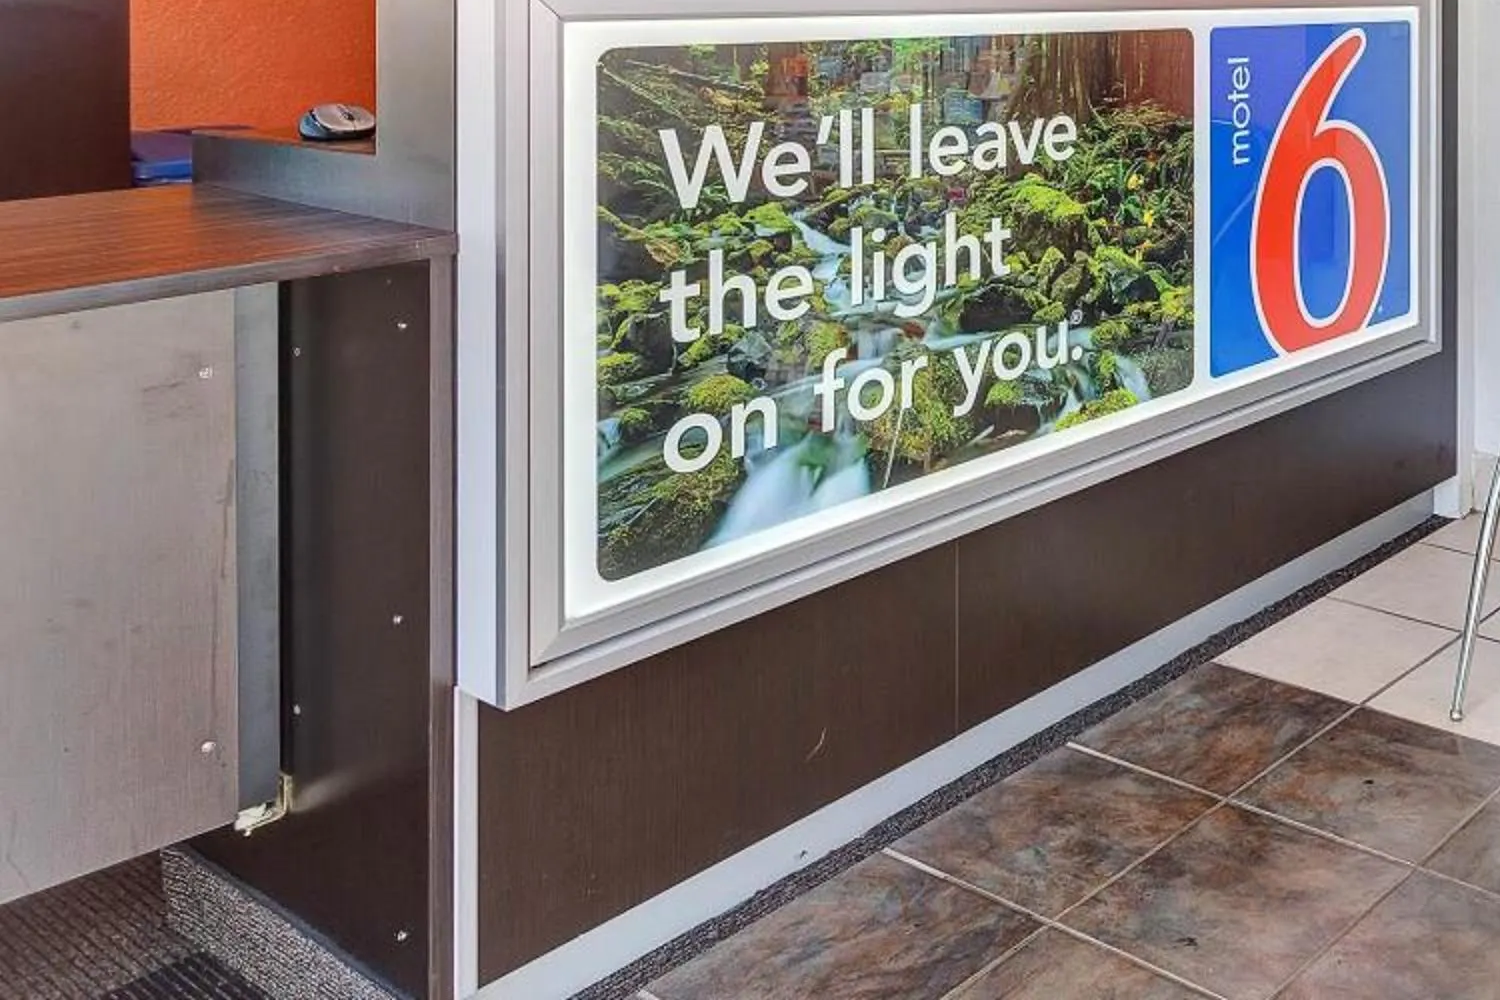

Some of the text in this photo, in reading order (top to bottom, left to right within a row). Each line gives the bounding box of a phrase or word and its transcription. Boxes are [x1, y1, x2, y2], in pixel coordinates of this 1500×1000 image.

[659, 103, 1077, 210] We'll leave
[1227, 27, 1391, 358] motel 6
[660, 212, 1011, 343] the light
[663, 397, 778, 473] on
[814, 347, 928, 433] for
